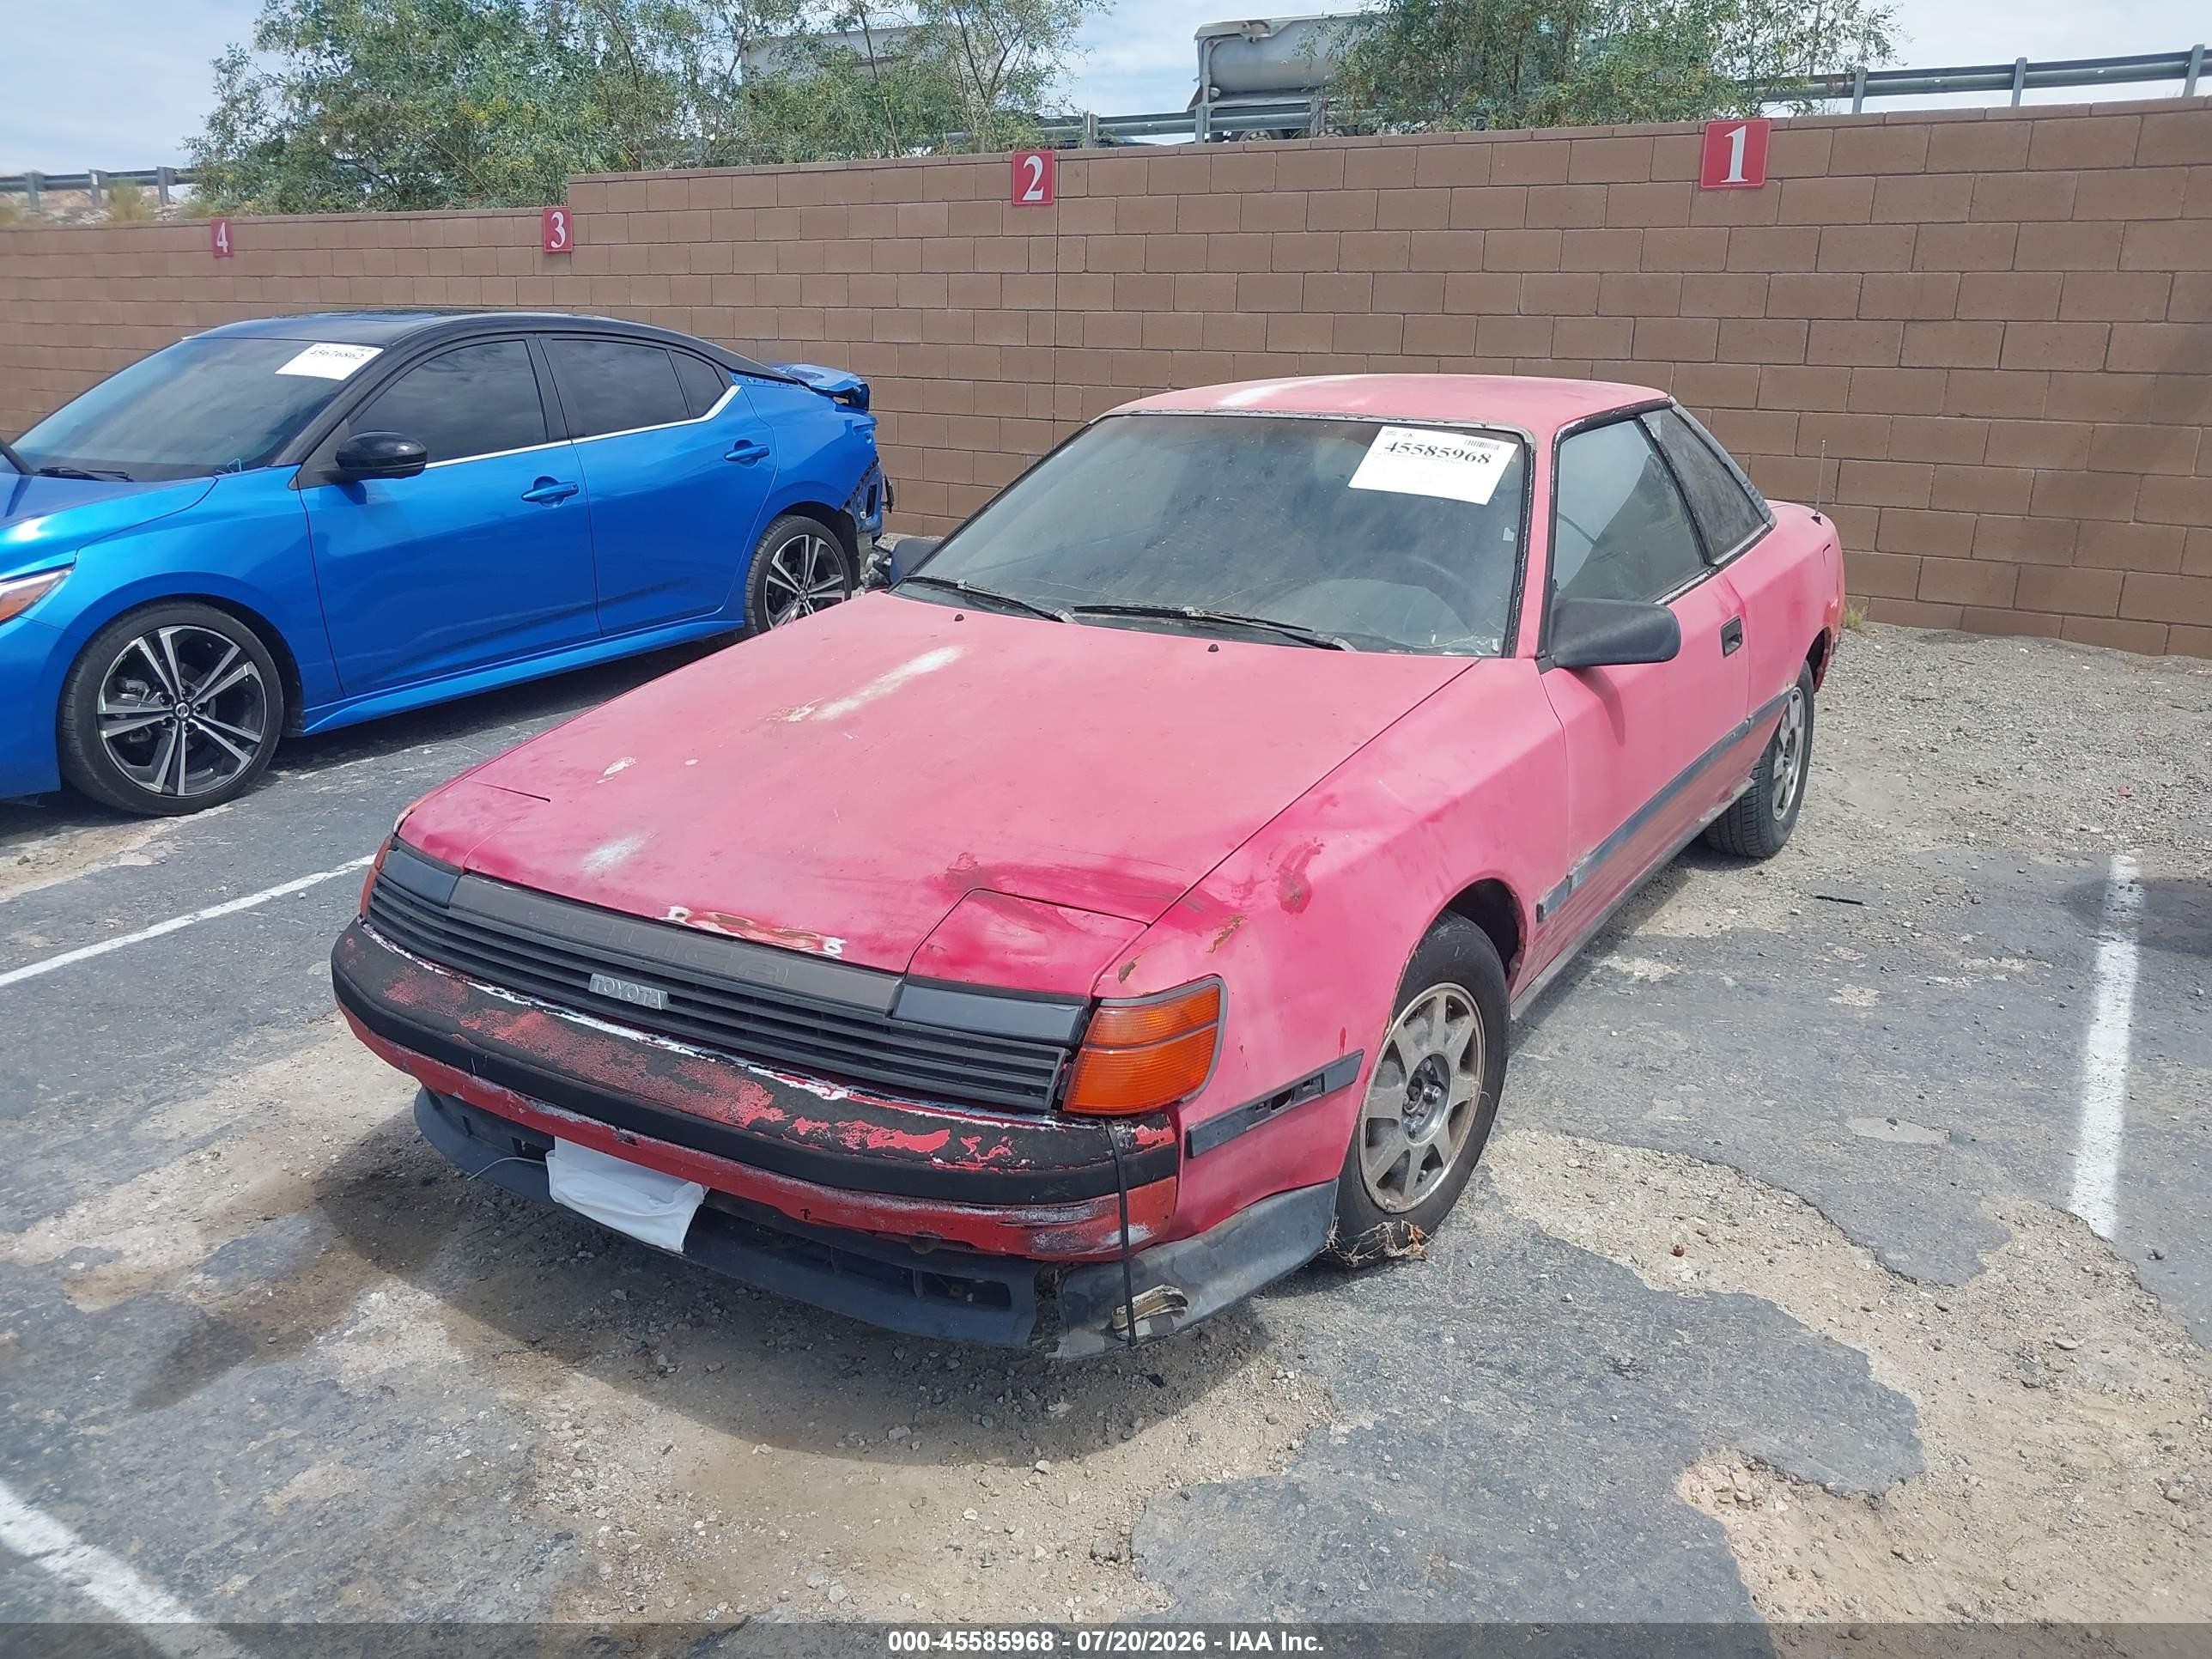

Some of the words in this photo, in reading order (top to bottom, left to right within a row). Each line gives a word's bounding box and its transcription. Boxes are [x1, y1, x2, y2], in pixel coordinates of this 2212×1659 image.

[1720, 125, 1748, 183] 1
[1022, 155, 1044, 201] 2
[216, 222, 228, 253] 4
[550, 212, 566, 247] 3
[1384, 441, 1492, 465] 45585968
[590, 975, 668, 1010] TOYOTA
